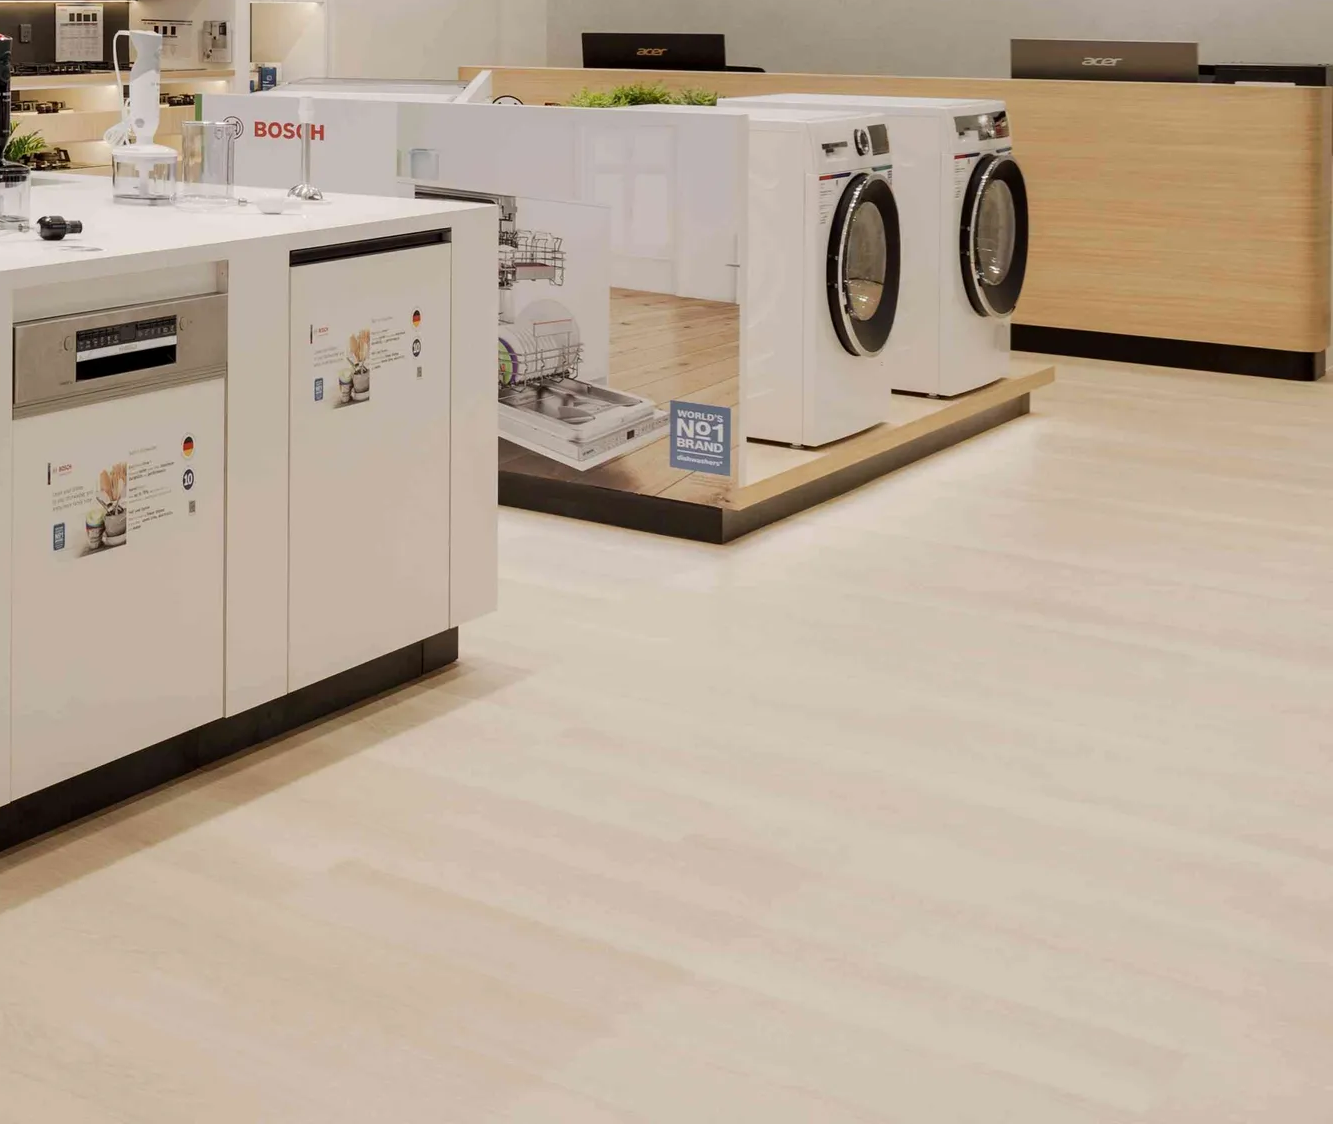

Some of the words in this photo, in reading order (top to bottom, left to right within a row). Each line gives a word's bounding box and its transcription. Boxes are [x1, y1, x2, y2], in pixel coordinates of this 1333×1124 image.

[636, 47, 668, 56] acer
[1081, 57, 1123, 66] acer
[676, 409, 724, 423] WORLD'S
[676, 436, 724, 454] BRAND
[183, 472, 193, 487] 10
